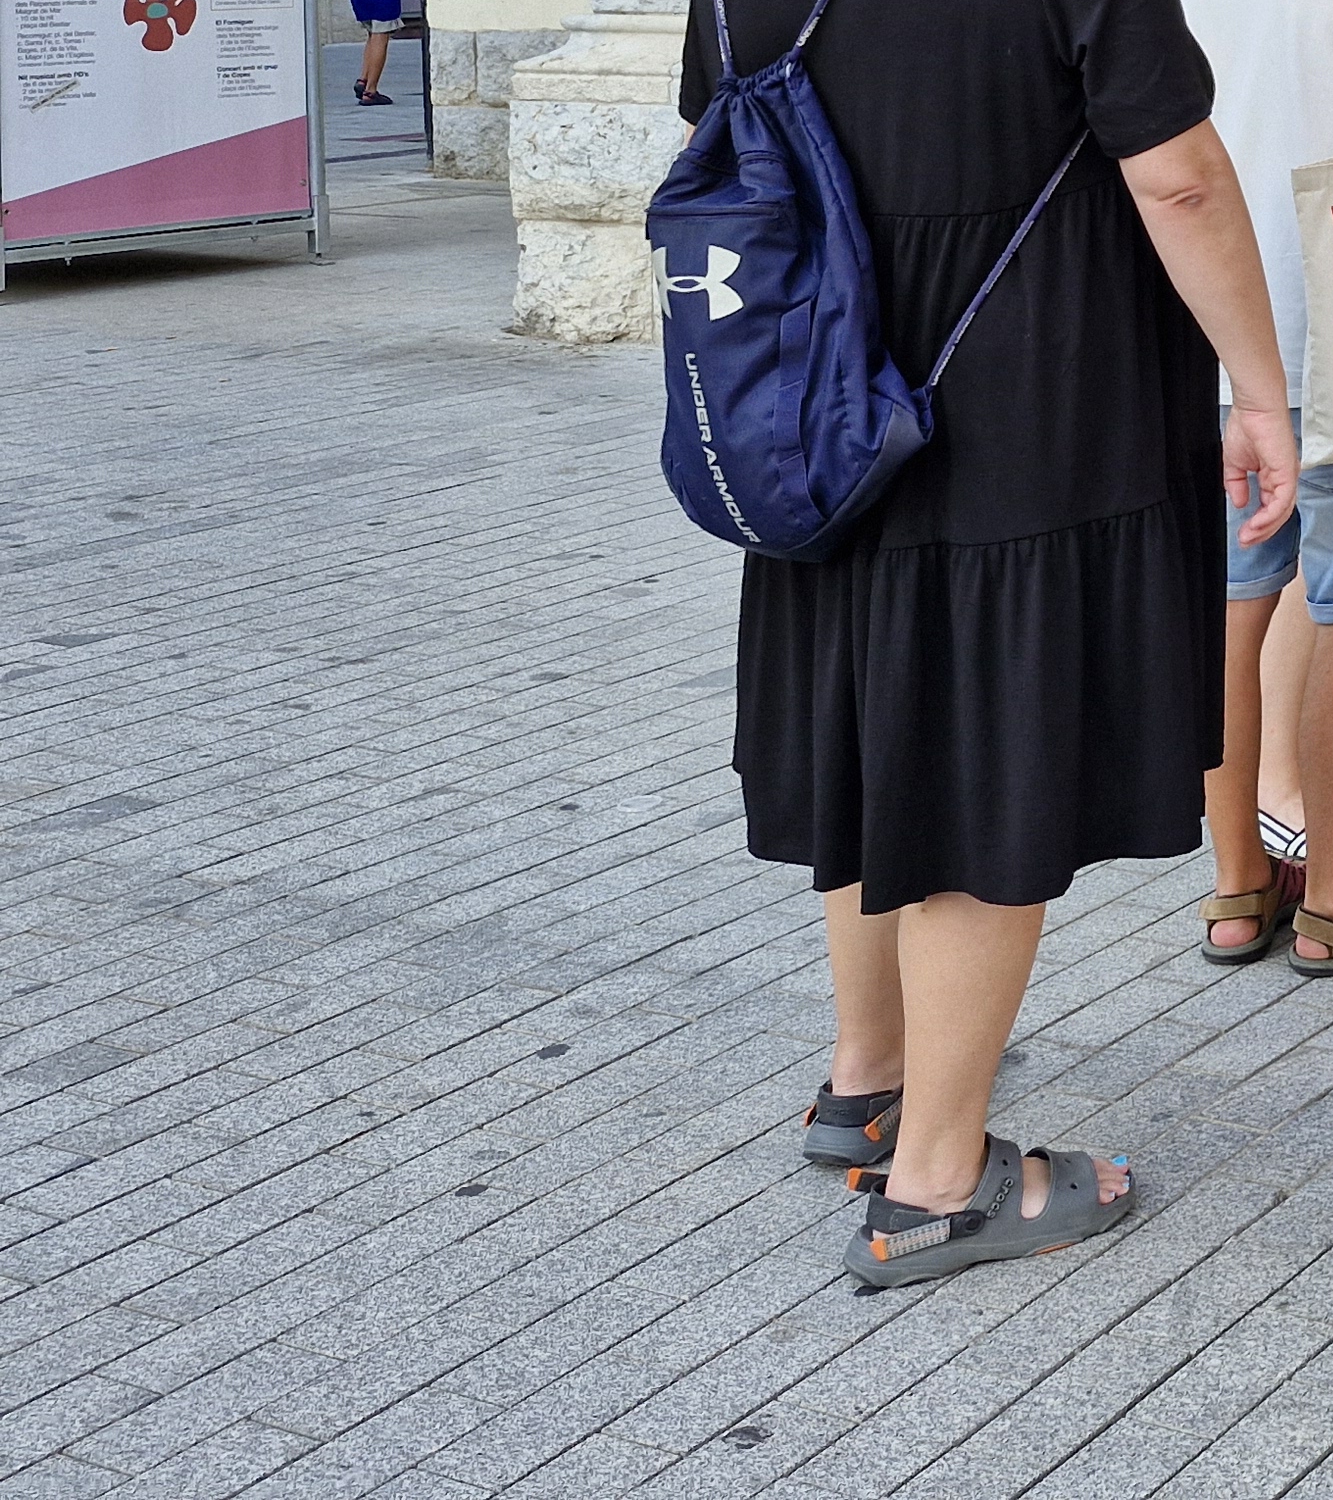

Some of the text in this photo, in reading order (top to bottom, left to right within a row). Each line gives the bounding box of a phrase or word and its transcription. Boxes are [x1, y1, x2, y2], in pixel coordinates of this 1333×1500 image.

[685, 353, 763, 544] UNDER ARMOUR
[986, 1177, 1015, 1219] crocs
